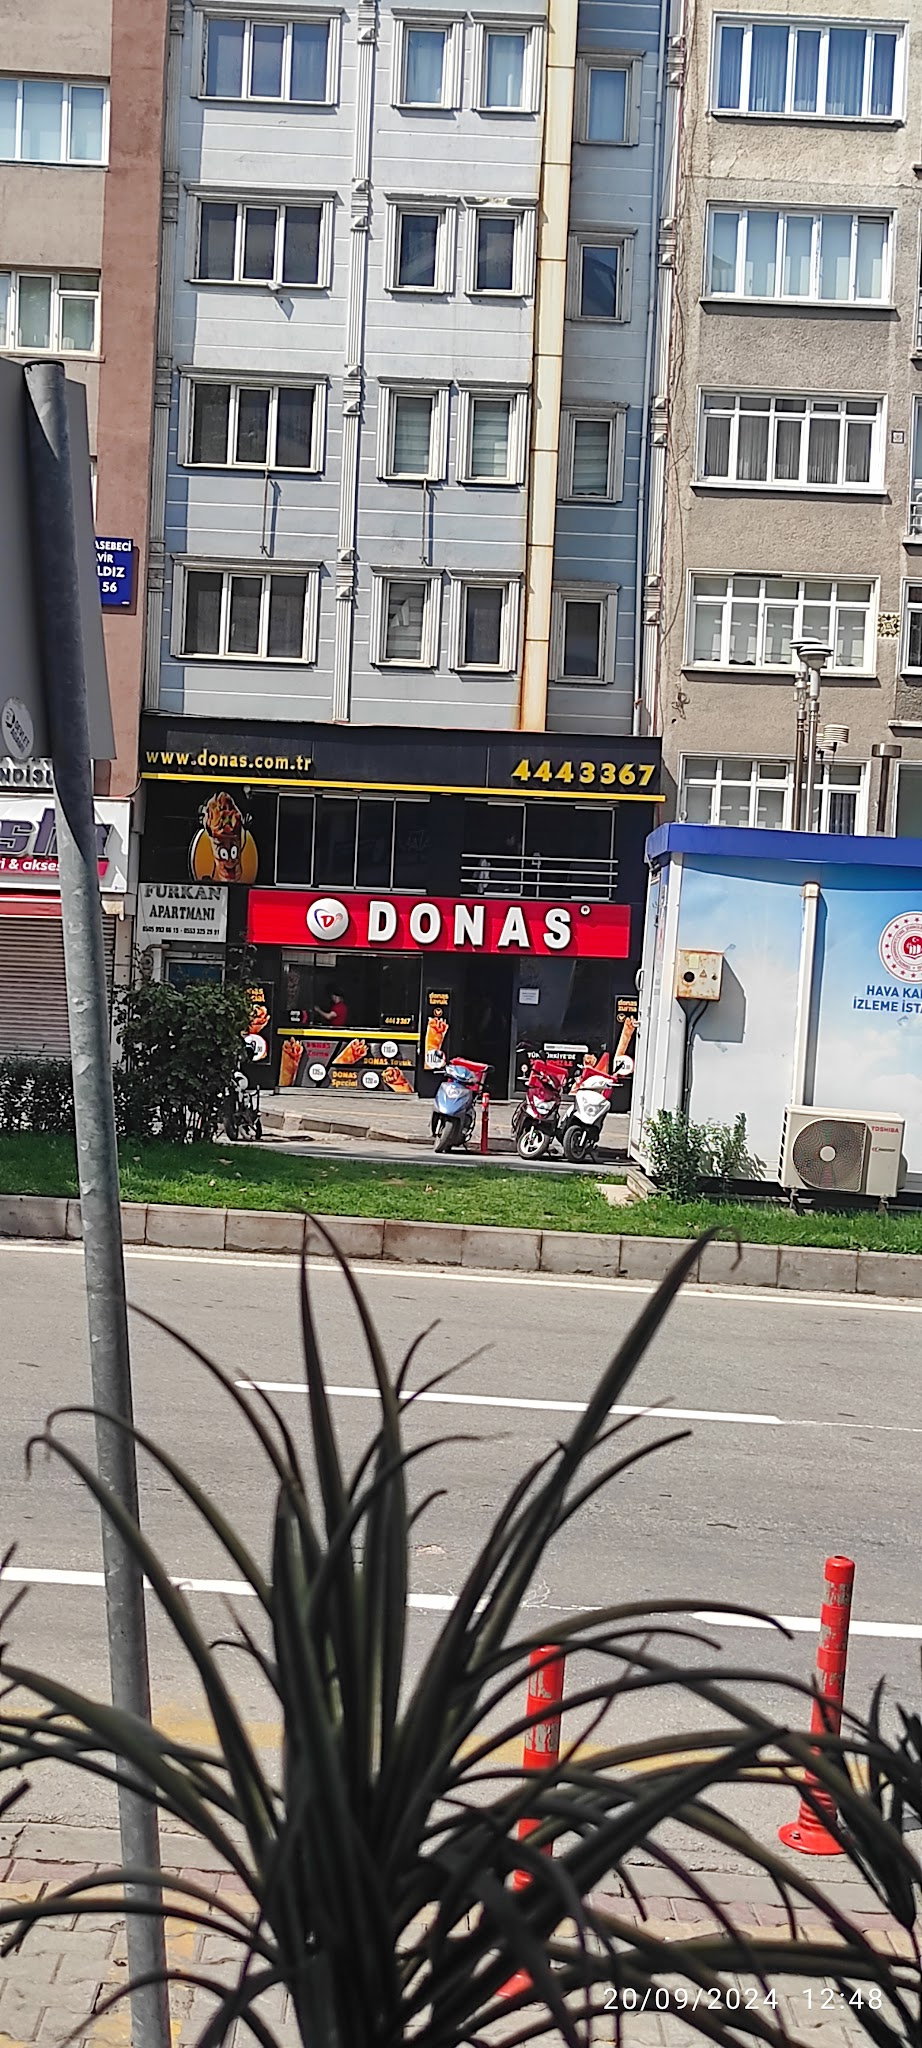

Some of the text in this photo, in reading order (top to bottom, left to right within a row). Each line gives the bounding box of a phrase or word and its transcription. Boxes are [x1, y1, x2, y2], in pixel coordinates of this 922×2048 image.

[96, 551, 114, 563] VİR
[101, 581, 118, 593] 56
[146, 748, 312, 771] www.donas.com.tr
[511, 758, 656, 786] 4443367
[143, 884, 222, 900] FURKAN
[149, 904, 216, 921] APARTMANI
[367, 900, 572, 949] DONAS
[867, 985, 899, 997] HAVA
[853, 996, 899, 1012] İZLEME
[332, 1071, 358, 1079] DONAS
[331, 1078, 358, 1088] Special
[871, 1125, 900, 1134] TOSHIBA
